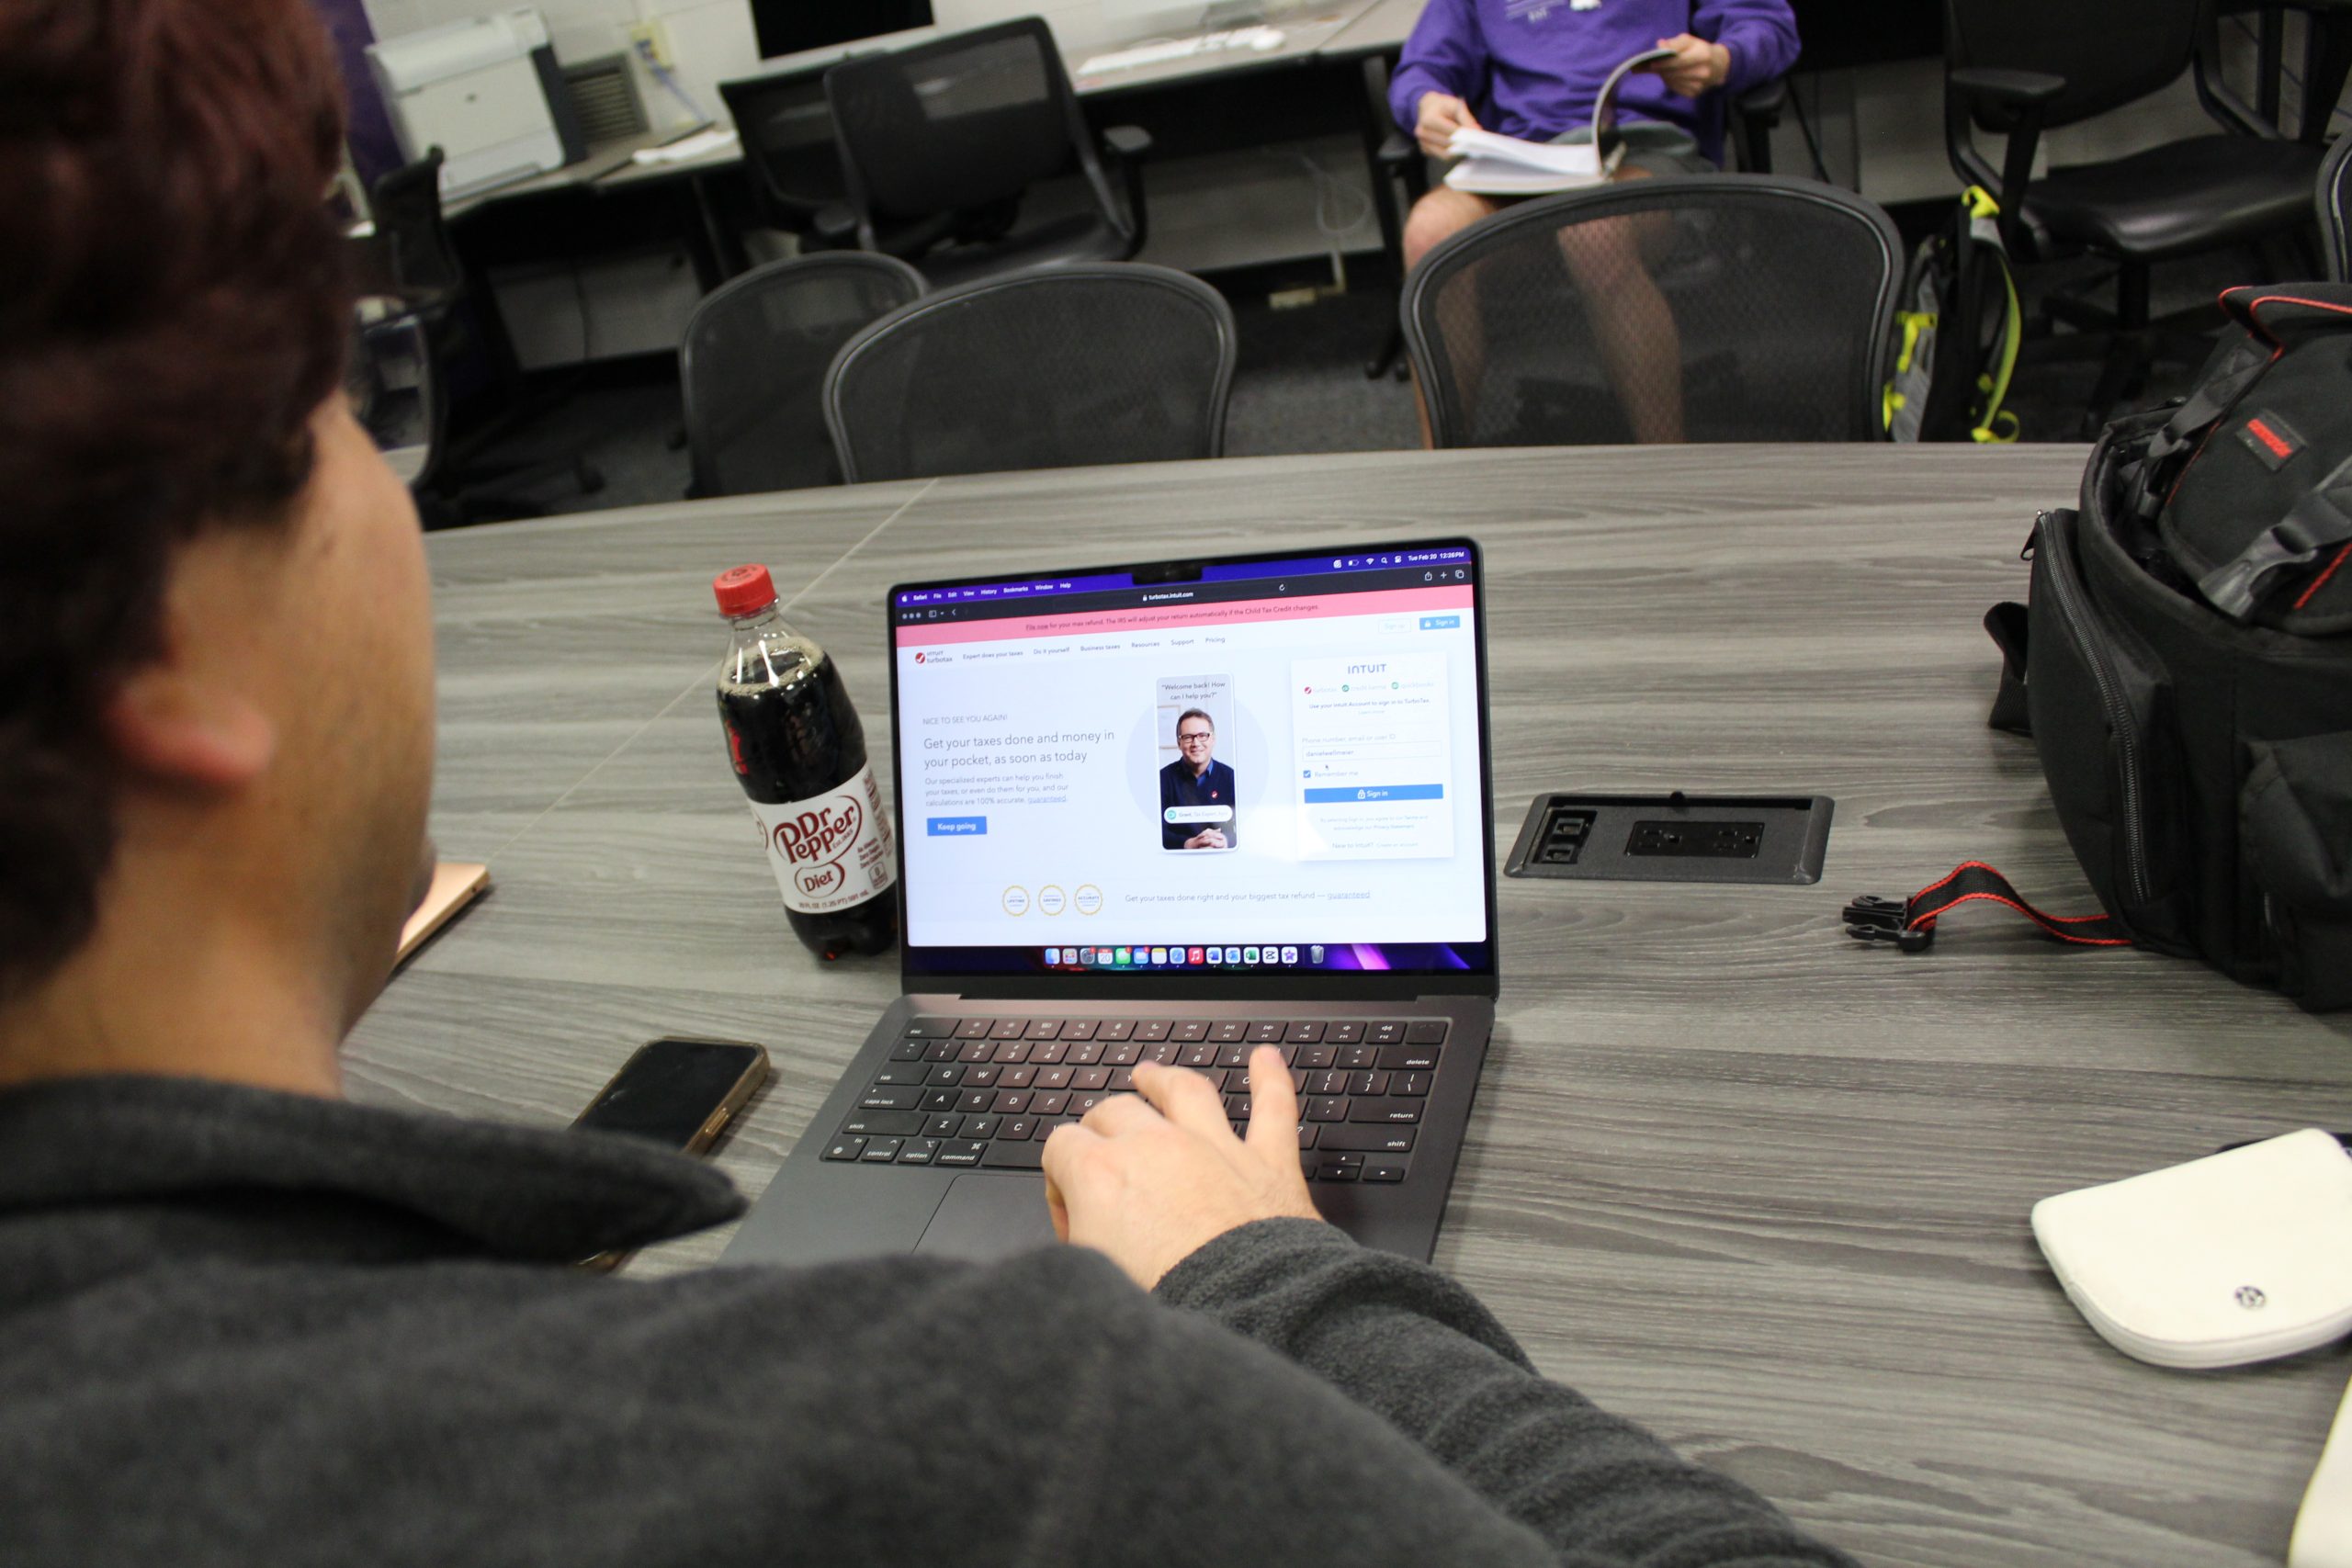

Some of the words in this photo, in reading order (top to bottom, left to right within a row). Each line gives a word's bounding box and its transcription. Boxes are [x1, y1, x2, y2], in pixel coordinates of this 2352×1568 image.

[1059, 581, 1071, 590] Help
[1138, 615, 1156, 624] adjust
[1189, 610, 1227, 619] automatically
[1435, 619, 1447, 627] Sign
[1170, 638, 1194, 648] Support
[1205, 637, 1226, 645] Pricing
[1047, 647, 1070, 655] yourself
[1161, 682, 1193, 691] "Welcome
[922, 717, 939, 726] NICE
[941, 716, 951, 725] TO
[952, 716, 965, 724] SEE
[966, 715, 981, 723] YOU
[982, 714, 1008, 722] AGAIN!
[923, 738, 944, 750] Get
[945, 739, 970, 751] your
[973, 737, 1001, 747] taxes
[1004, 734, 1035, 746] done
[1036, 732, 1058, 744] and
[1062, 733, 1102, 744] money
[1104, 729, 1115, 740] in
[924, 758, 948, 771] your
[951, 754, 992, 769] pocket,
[994, 755, 1007, 764] as
[1009, 753, 1036, 764] soon
[1039, 753, 1052, 762] as
[1055, 750, 1088, 763] today
[924, 777, 938, 785] Our
[939, 775, 975, 785] specialized
[976, 775, 1001, 784] experts
[1014, 773, 1030, 782] help
[1046, 772, 1064, 780] finish
[986, 785, 996, 794] do
[1366, 790, 1381, 798] Sign
[925, 798, 964, 807] calculations
[976, 796, 995, 805] 100%
[797, 807, 831, 839] Dr
[937, 823, 956, 831] Keep
[956, 822, 977, 832] going
[773, 806, 854, 864] Pepper
[804, 870, 834, 893] Diet
[1176, 893, 1195, 901] done
[1196, 893, 1214, 903] right
[1215, 893, 1229, 901] and
[1230, 894, 1248, 902] your
[1249, 892, 1277, 902] biggest
[1290, 892, 1316, 900] refund
[1101, 954, 1111, 963] 20
[943, 1070, 952, 1078] Q
[972, 1096, 981, 1104] S
[1009, 1097, 1018, 1105] D
[1046, 1098, 1056, 1106] F
[939, 1121, 949, 1129] Z
[976, 1122, 986, 1130] X
[1013, 1122, 1023, 1132] C
[905, 1152, 928, 1160] option
